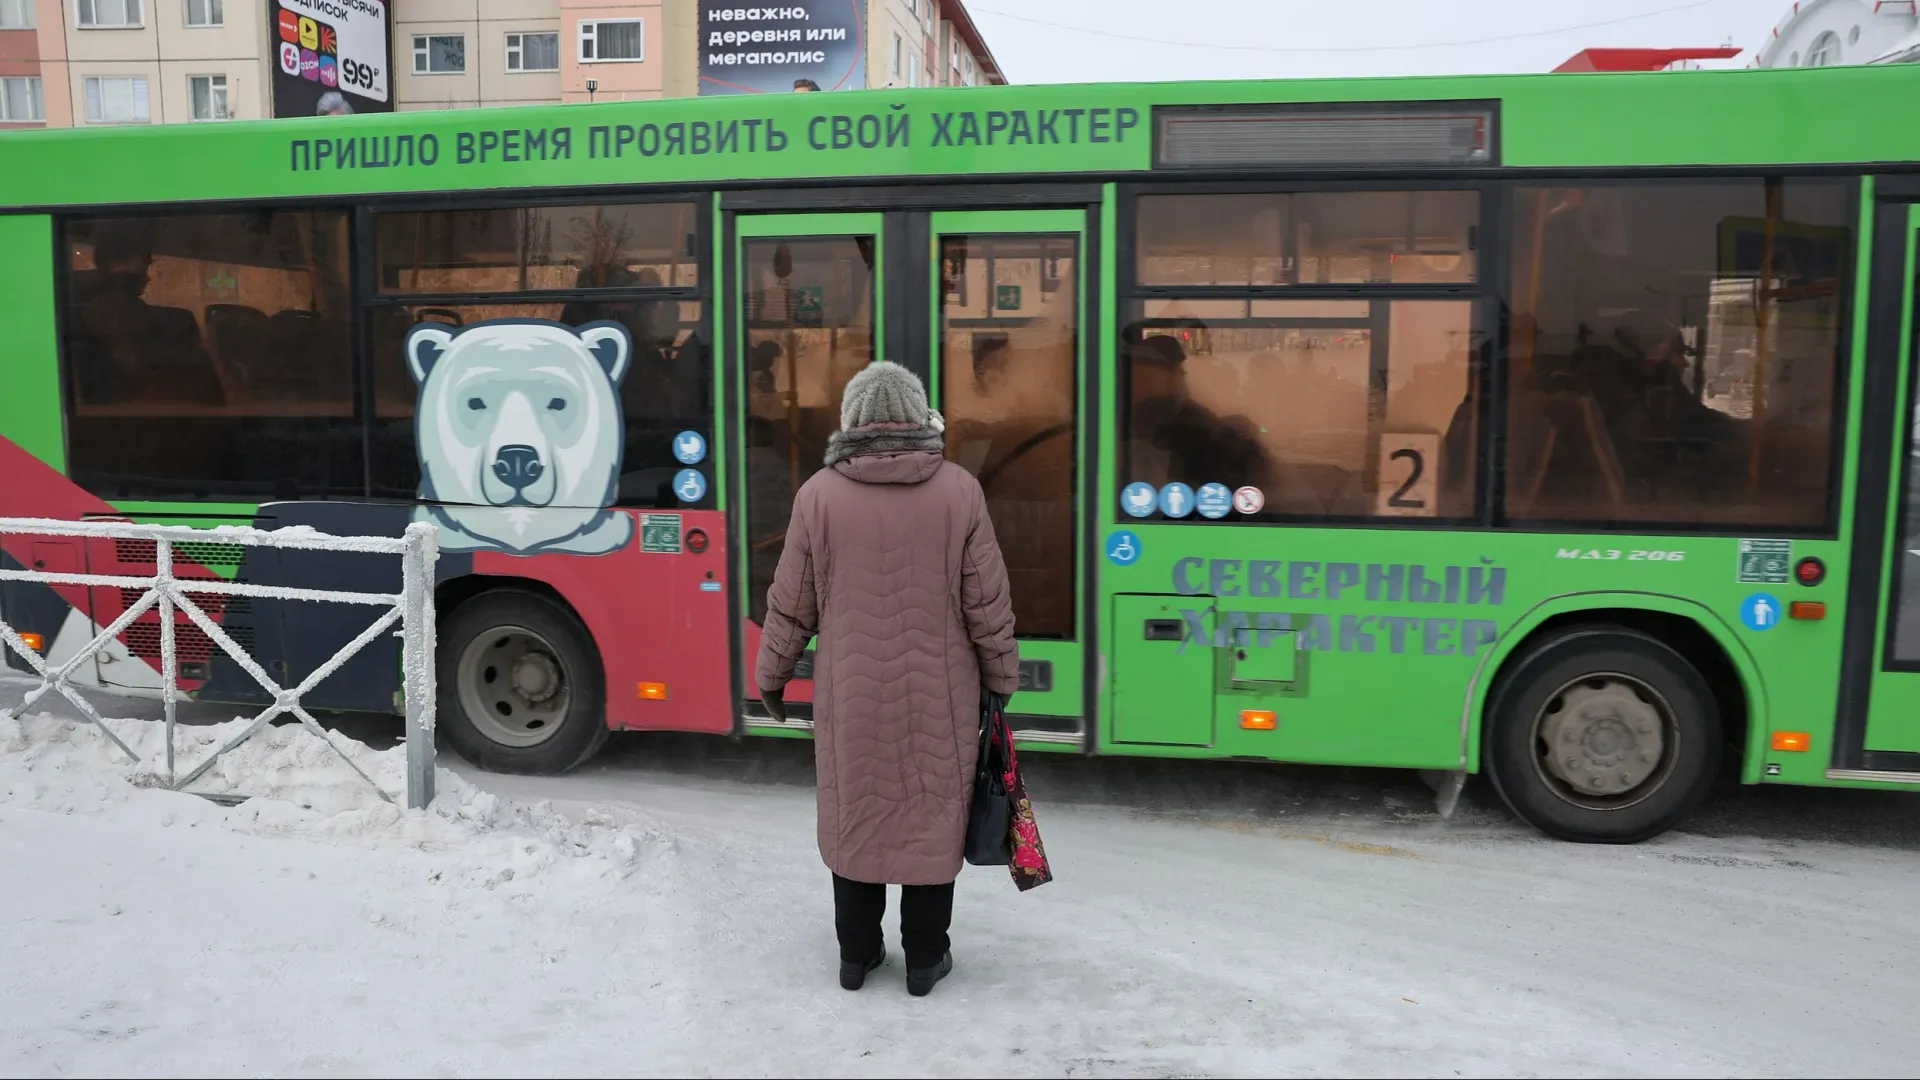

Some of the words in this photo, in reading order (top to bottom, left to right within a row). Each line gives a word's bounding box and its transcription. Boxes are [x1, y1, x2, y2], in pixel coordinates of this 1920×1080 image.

[708, 7, 810, 21] неважно,
[708, 29, 801, 46] деревня
[806, 28, 846, 41] или
[300, 60, 320, 70] OZON
[708, 51, 825, 65] мегаполис
[291, 133, 440, 171] ПРИШЛО
[456, 126, 573, 165] ВРЕМЯ
[588, 118, 789, 159] ПРОЯВИТЬ
[807, 103, 910, 150] СВОЙ
[930, 107, 1140, 147] ХАРАКТЕР
[1387, 448, 1426, 508] 2
[1627, 550, 1687, 562] 206
[1172, 555, 1507, 605] СЕВЕРНЫЙ
[1176, 605, 1498, 656] ХАРАКТЕР
